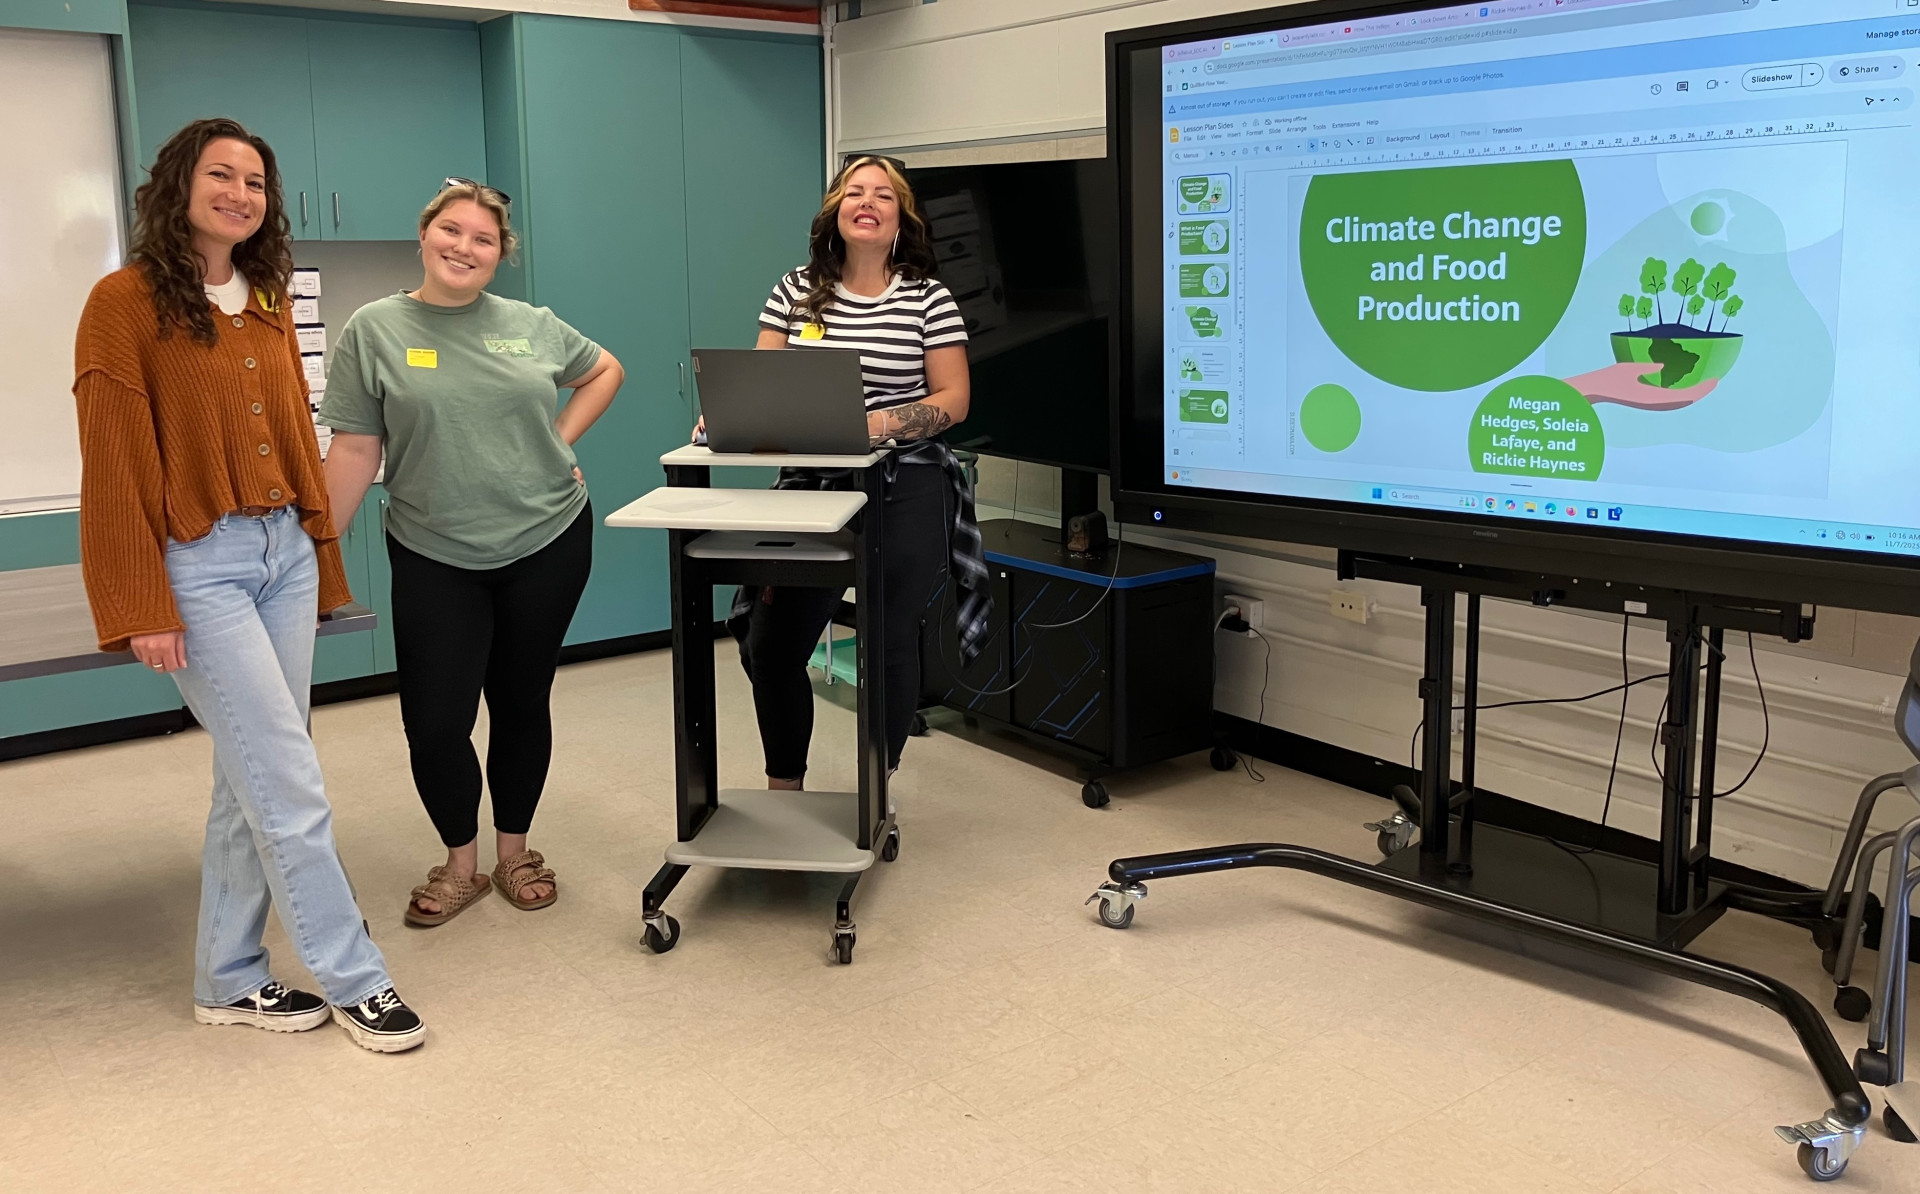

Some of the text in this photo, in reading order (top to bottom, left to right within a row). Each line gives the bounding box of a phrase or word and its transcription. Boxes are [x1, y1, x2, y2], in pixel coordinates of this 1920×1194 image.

[1866, 29, 1899, 39] Manage
[1460, 74, 1481, 82] Google
[1751, 72, 1793, 84] Slideshow
[1854, 65, 1880, 74] Share
[1183, 122, 1234, 133] Lesson Plan Sides
[1332, 121, 1361, 129] Extensions
[1386, 126, 1523, 143] Background Layout Theme Transition
[1325, 211, 1562, 245] Climate Change
[1370, 251, 1507, 282] and Food
[1358, 294, 1520, 322] Production
[1508, 396, 1560, 414] Megan
[1481, 414, 1589, 432] Hedges, Soleia
[1492, 433, 1576, 452] Lafaye, and
[1482, 452, 1586, 473] Rickie Haynes
